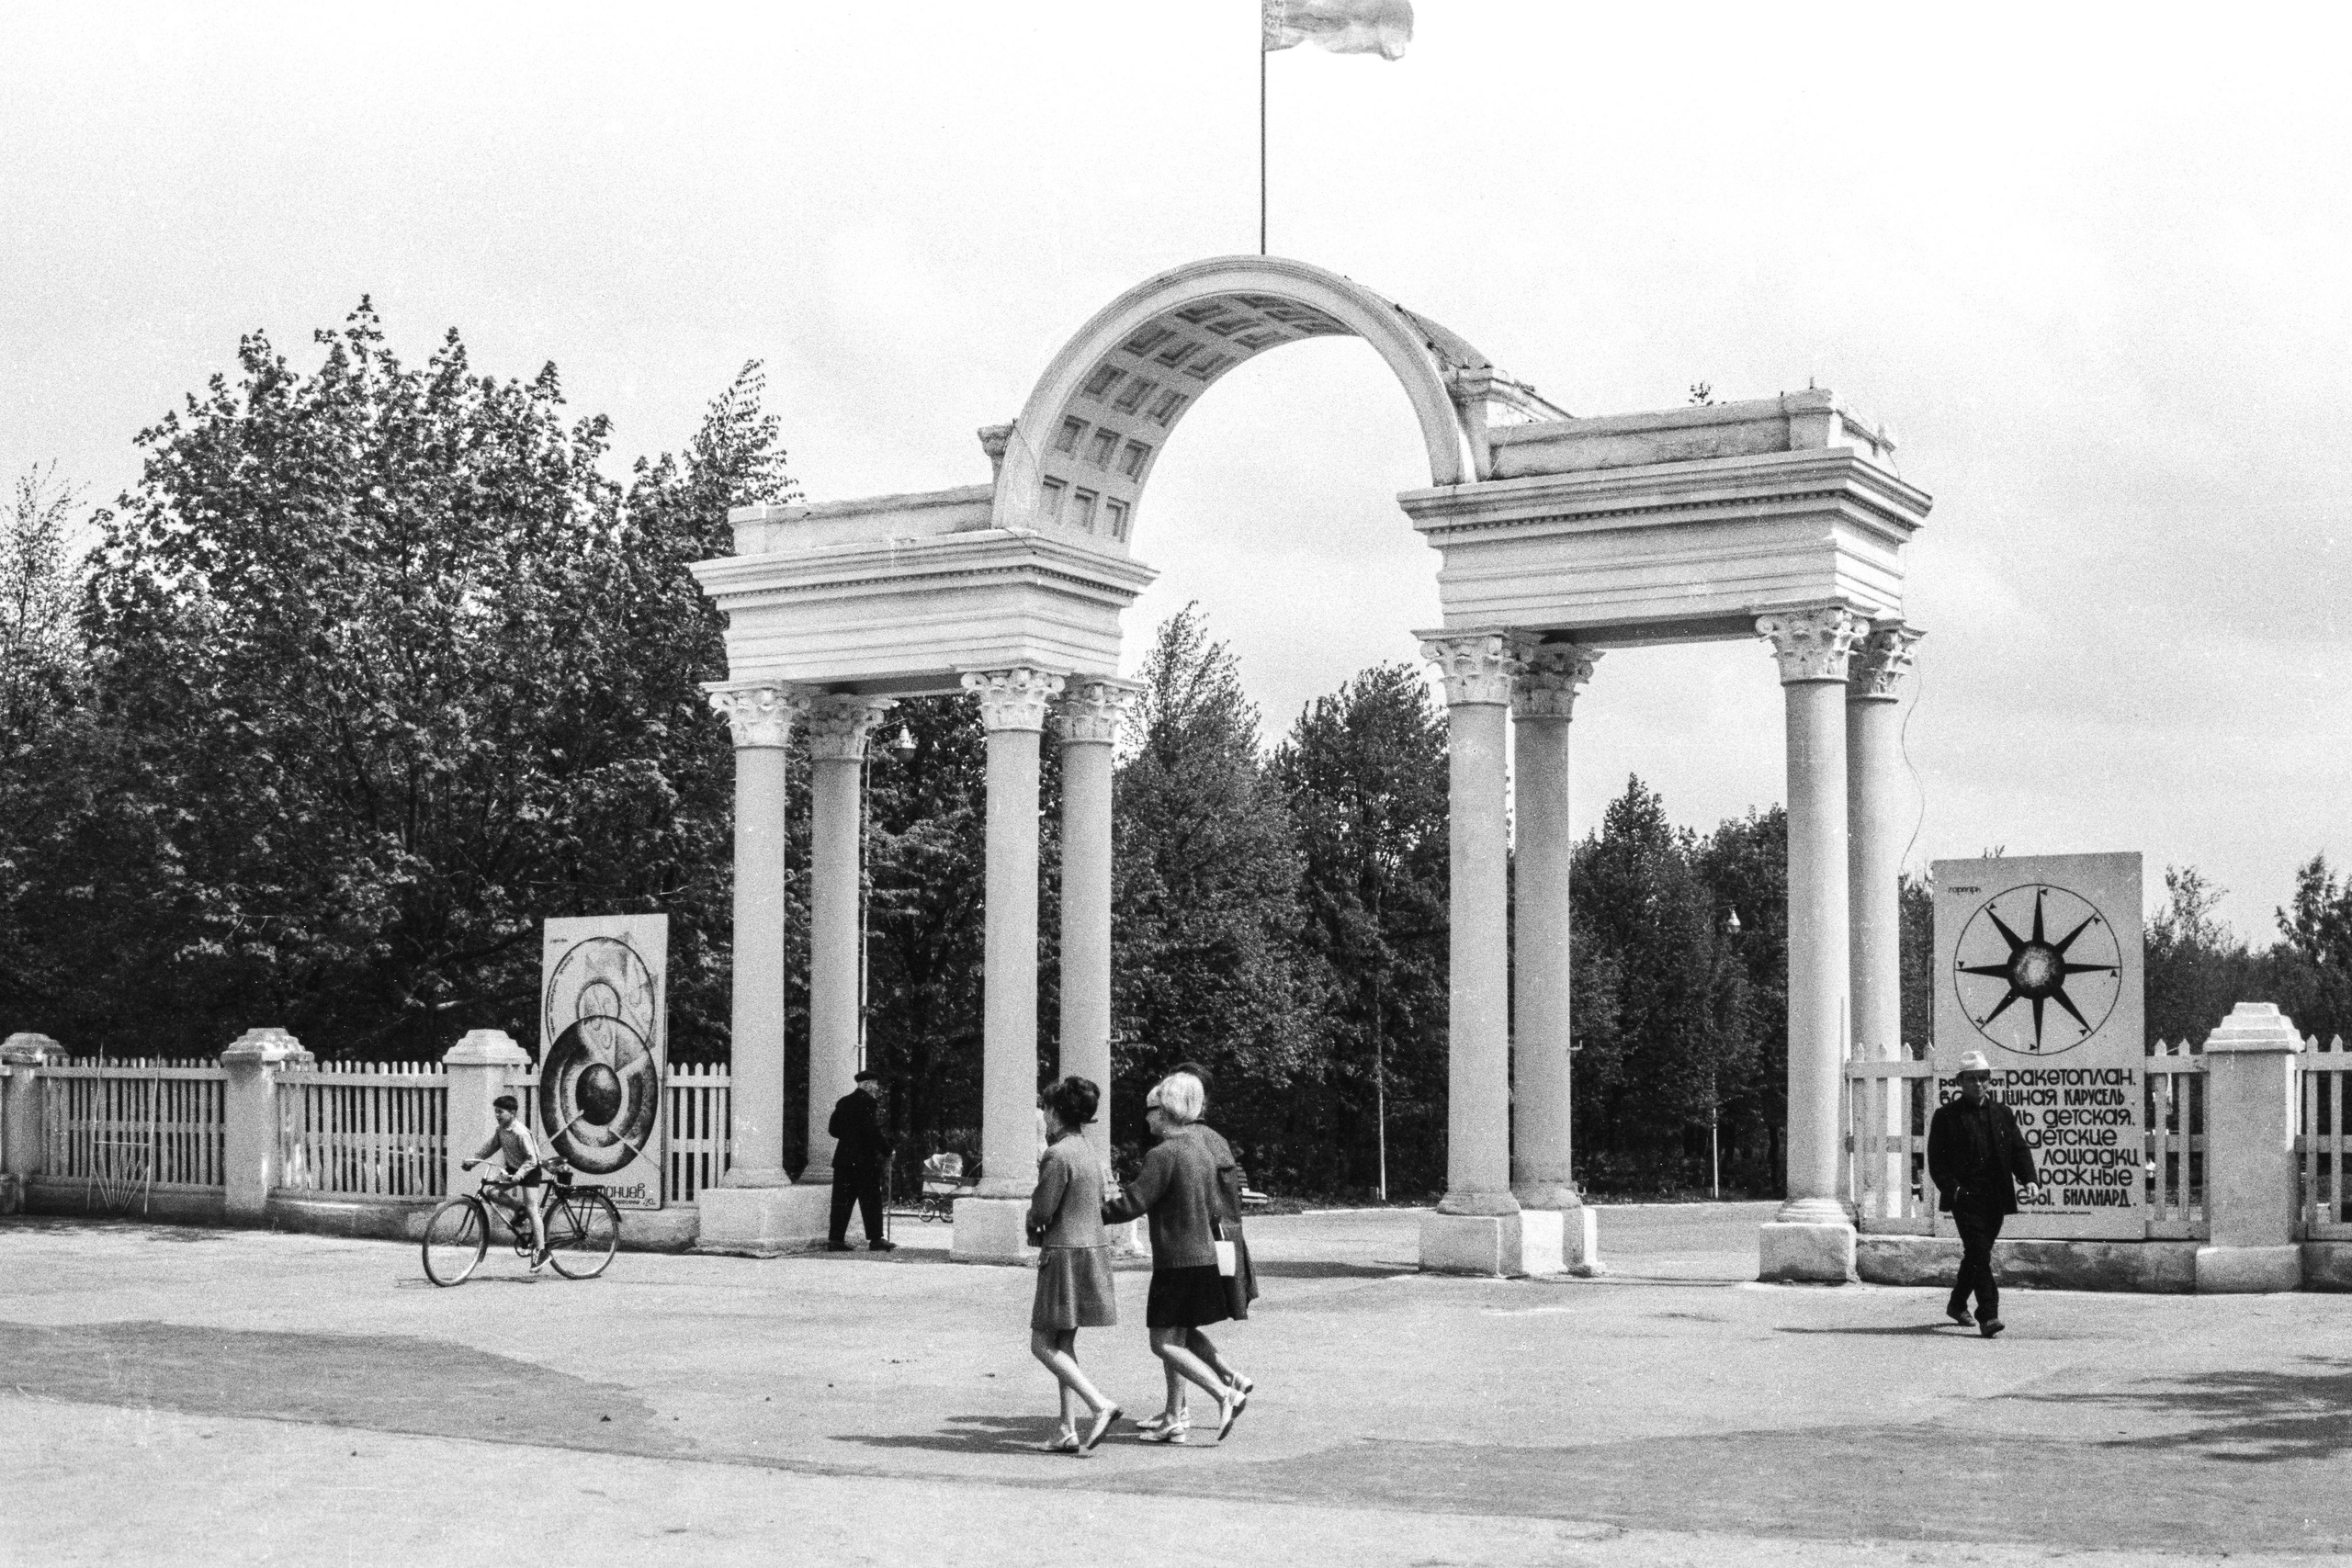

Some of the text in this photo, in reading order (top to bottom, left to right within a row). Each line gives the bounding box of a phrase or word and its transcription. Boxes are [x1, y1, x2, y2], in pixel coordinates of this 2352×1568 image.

[2006, 1068, 2137, 1089] ракетоплан.
[2042, 1109, 2136, 1128] детская.
[2025, 1128, 2118, 1149] детские
[2042, 1148, 2141, 1170] лошадки
[2063, 1188, 2137, 1208] БИЛЛИАРД.
